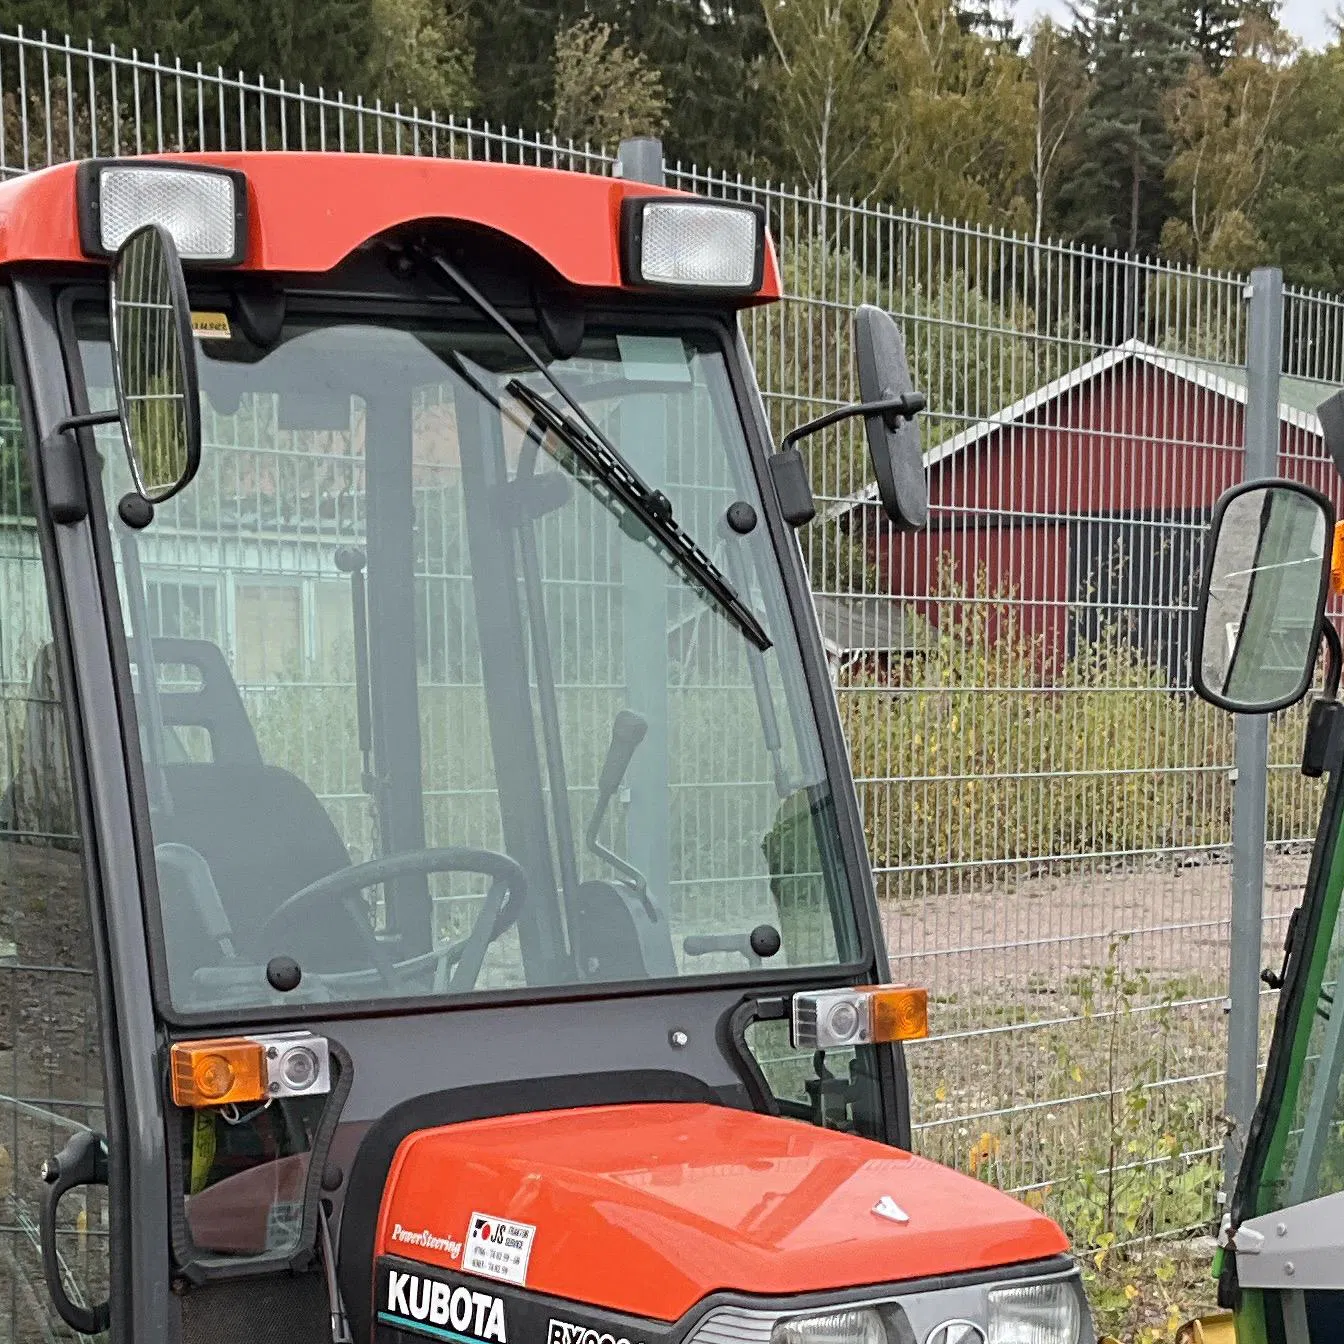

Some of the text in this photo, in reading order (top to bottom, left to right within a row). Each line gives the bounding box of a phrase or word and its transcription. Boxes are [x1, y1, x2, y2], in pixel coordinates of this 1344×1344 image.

[391, 1223, 463, 1260] PowerSteering
[490, 1223, 506, 1245] JS
[387, 1270, 507, 1344] KUBOTA
